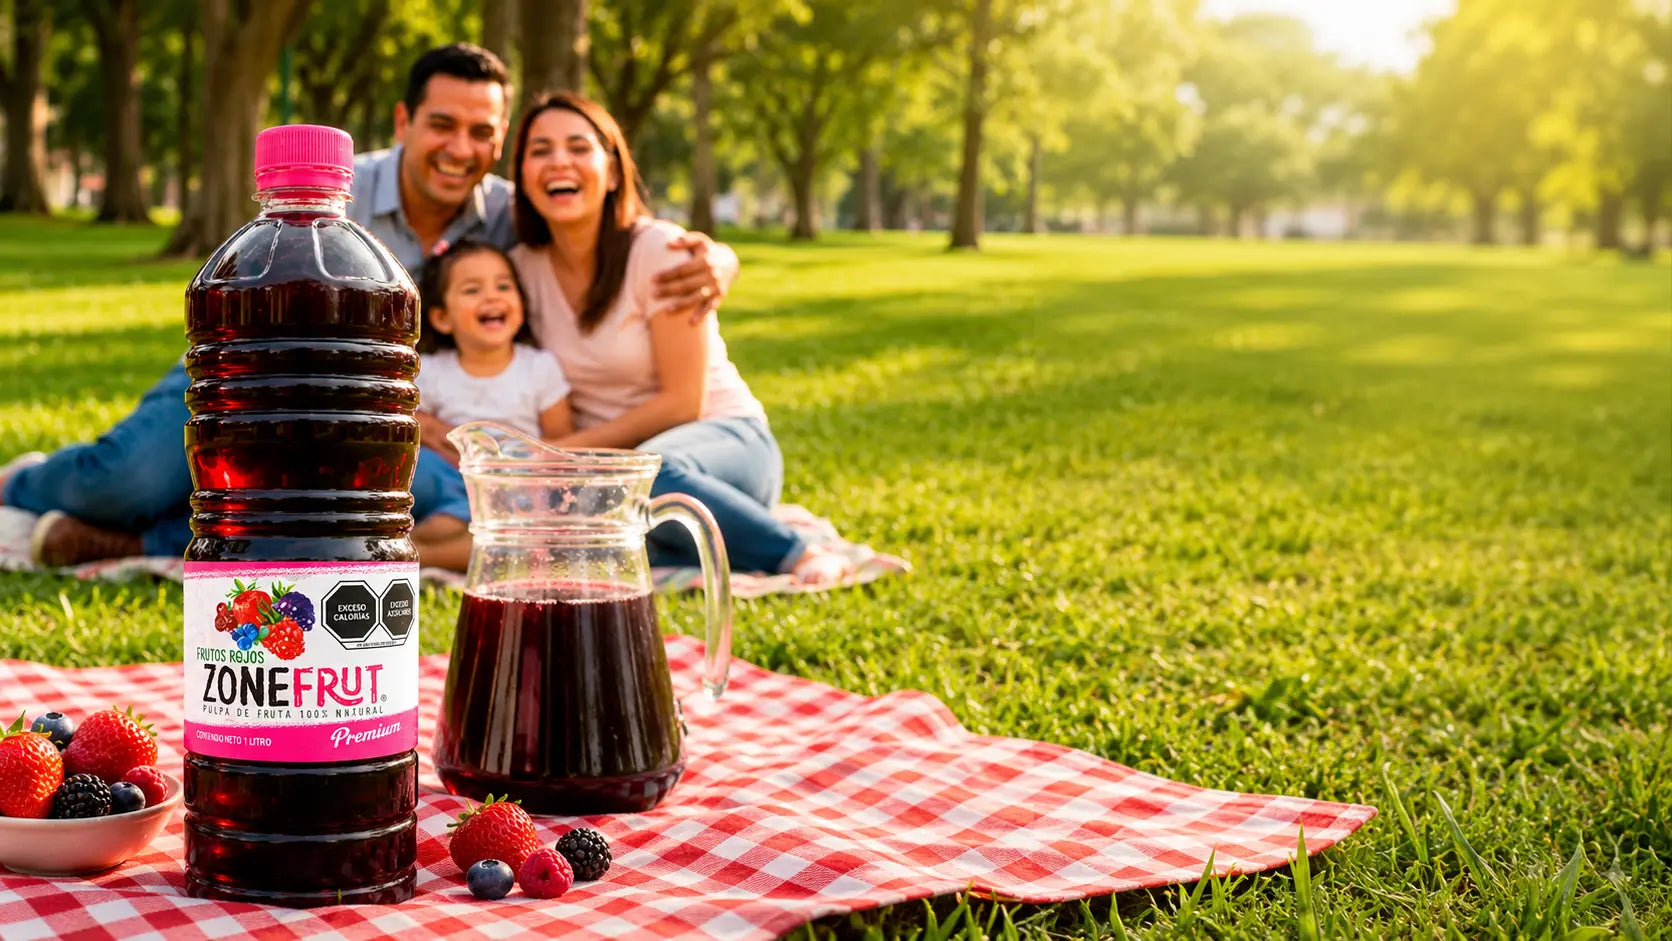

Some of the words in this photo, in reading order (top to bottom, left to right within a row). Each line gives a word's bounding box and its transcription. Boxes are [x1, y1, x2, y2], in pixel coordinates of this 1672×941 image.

[338, 603, 367, 613] EXCESO
[197, 647, 226, 662] FRUTOS
[229, 650, 264, 664] ROJOS
[203, 705, 230, 716] PULPA
[236, 708, 249, 718] DE
[257, 709, 291, 719] FRUTA
[300, 709, 328, 719] 100%
[330, 721, 401, 748] Premium
[243, 737, 248, 746] 1
[249, 737, 272, 747] LITRO
